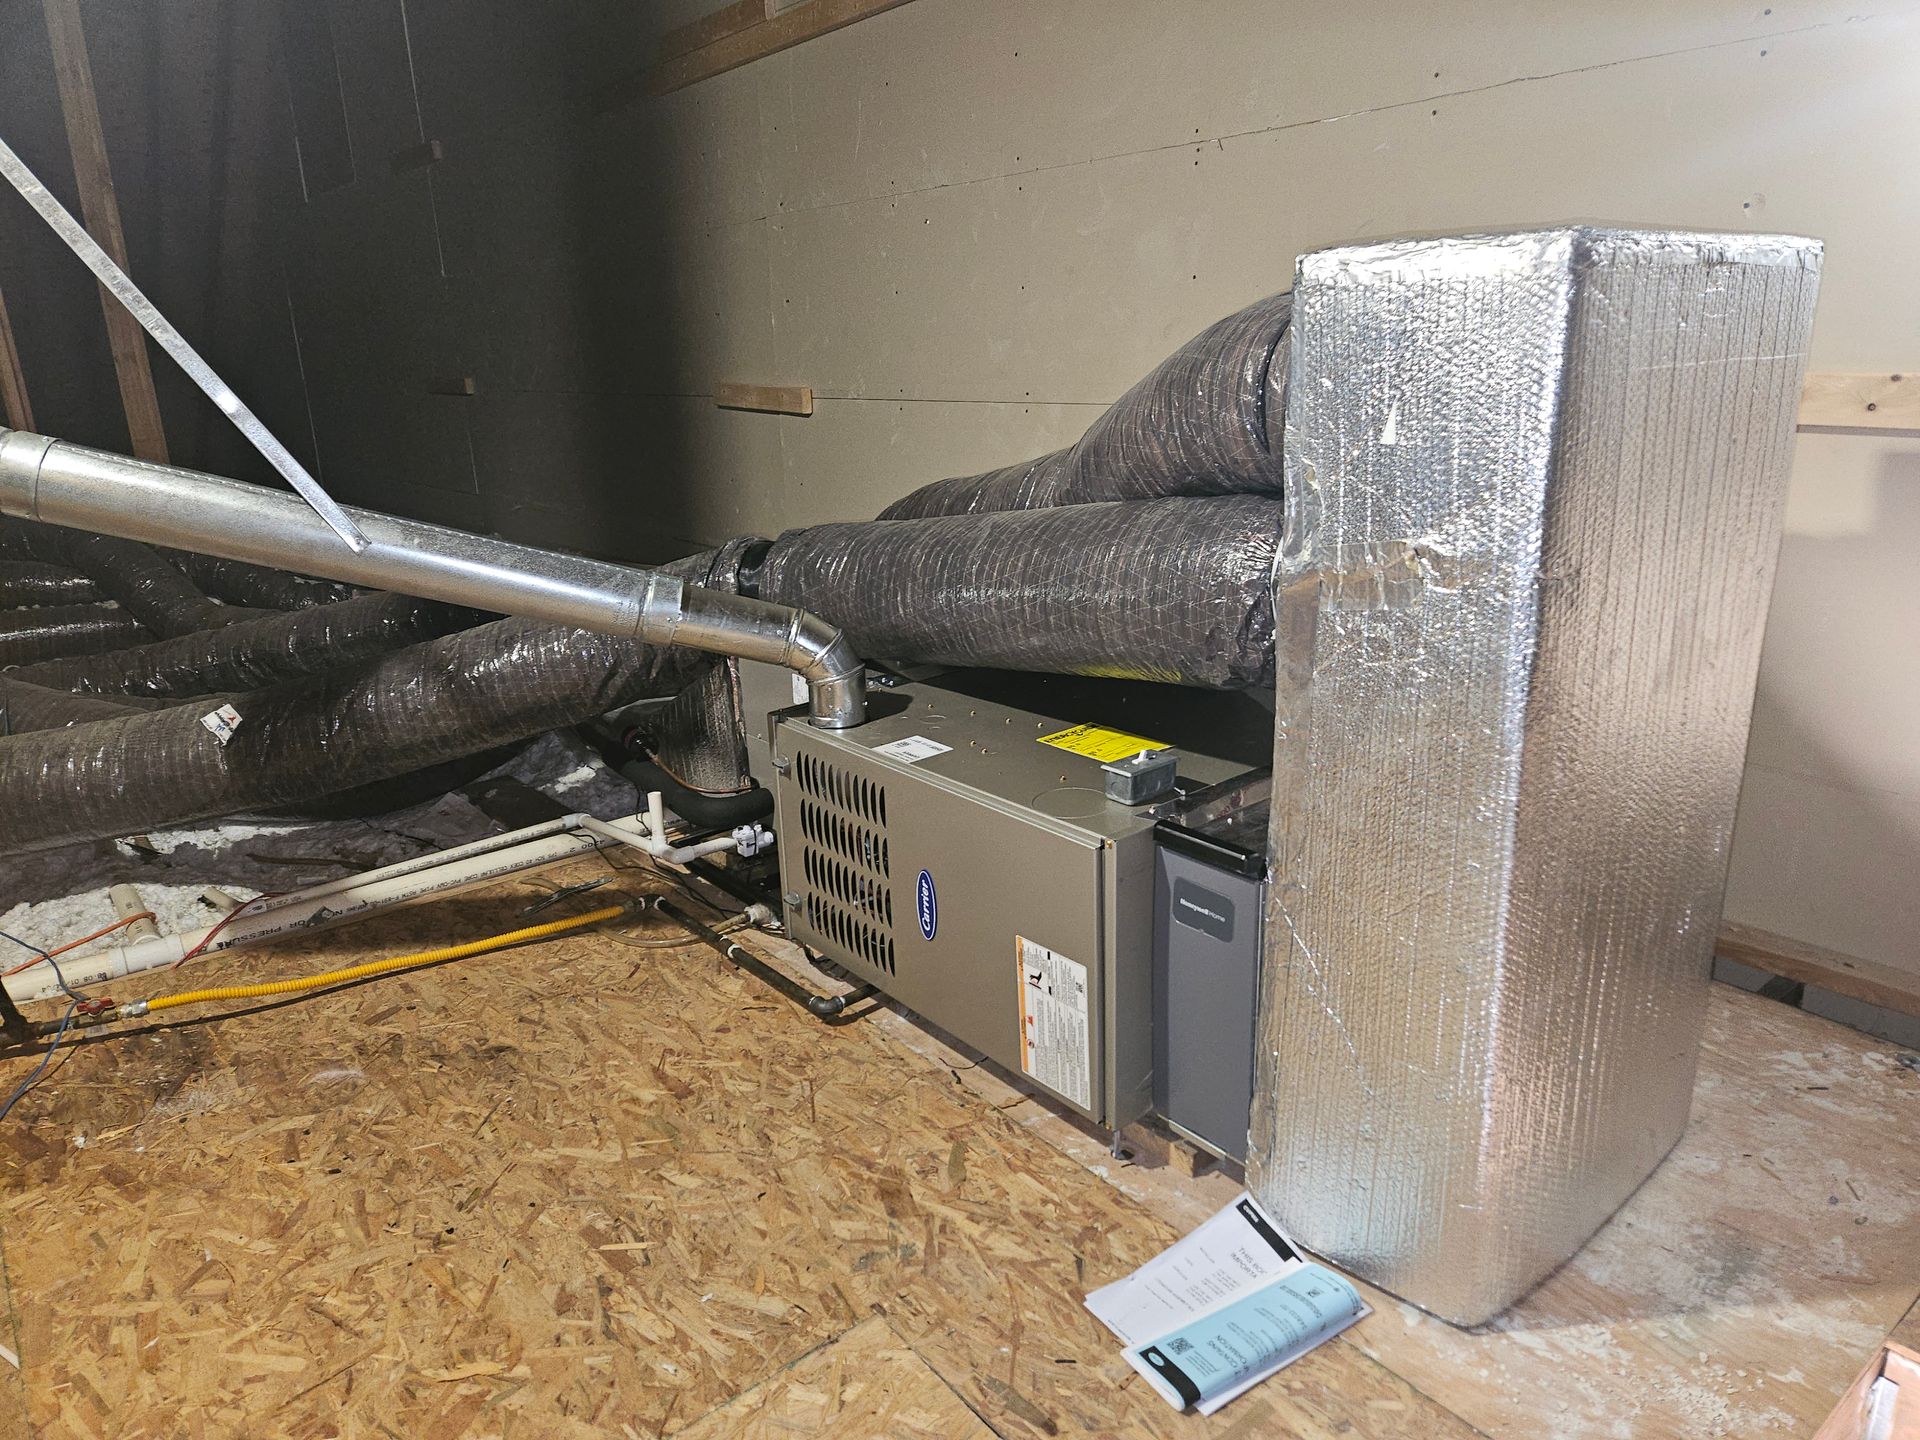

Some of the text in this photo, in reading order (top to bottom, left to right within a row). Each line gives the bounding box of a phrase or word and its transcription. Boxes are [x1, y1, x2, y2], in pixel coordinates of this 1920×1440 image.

[464, 873, 478, 881] CORE
[480, 866, 508, 877] CELLULAR
[921, 879, 930, 932] Carrier
[216, 928, 283, 950] PRESSURE
